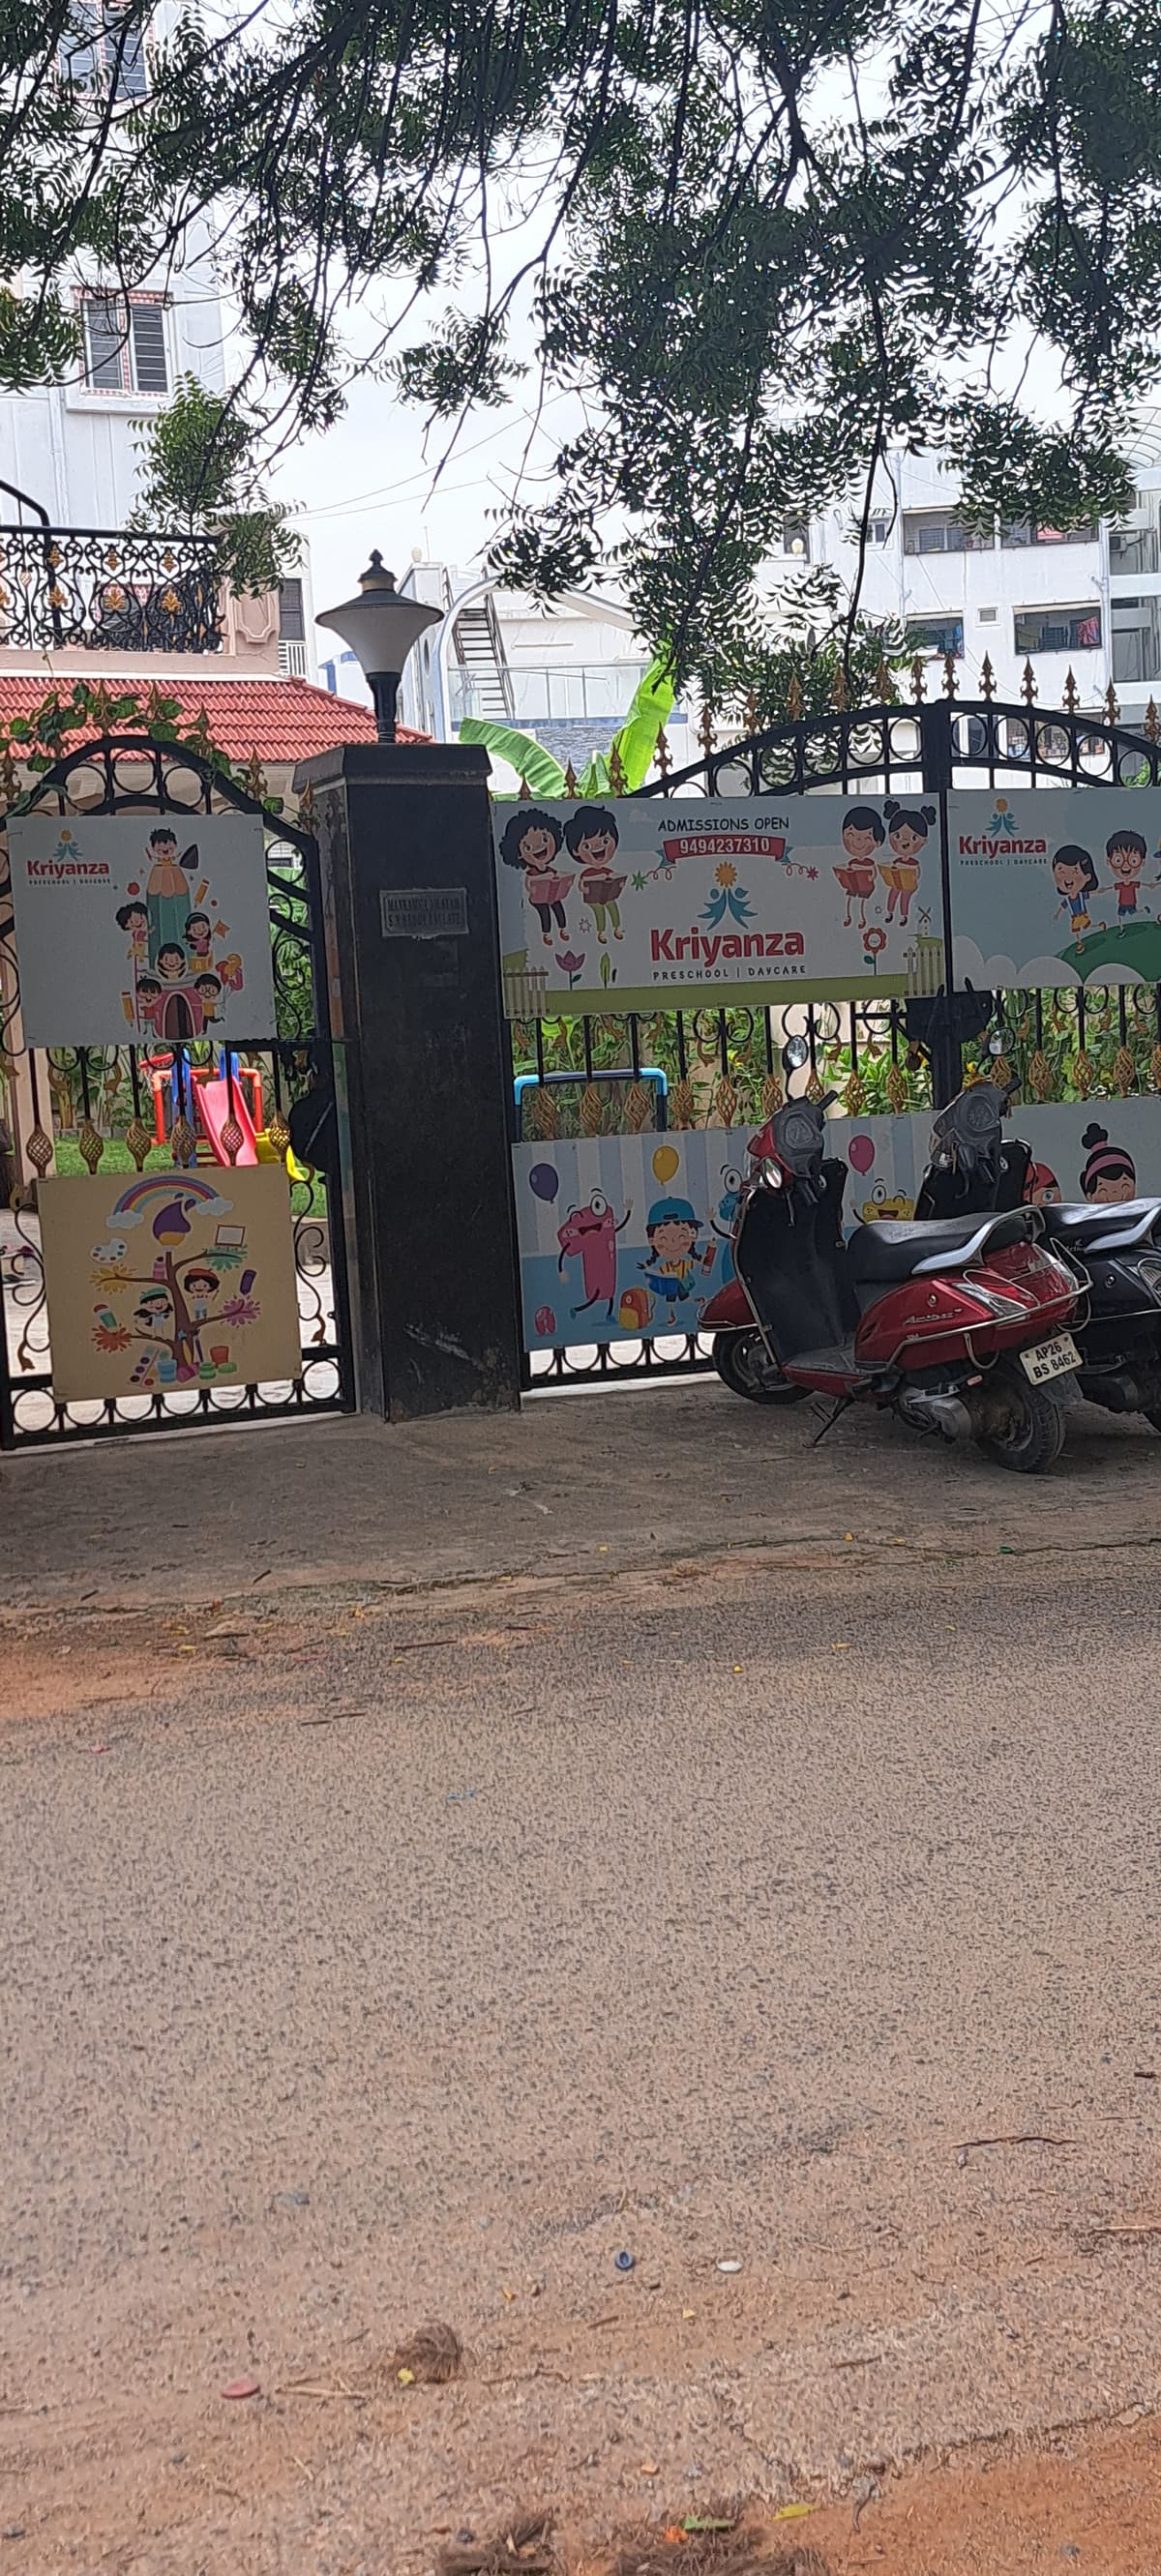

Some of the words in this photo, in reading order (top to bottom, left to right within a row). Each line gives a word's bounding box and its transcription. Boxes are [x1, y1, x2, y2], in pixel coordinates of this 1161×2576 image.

[658, 818, 749, 832] ADMISSIONS
[755, 816, 789, 830] OPEN
[679, 837, 770, 854] 9494237310
[959, 835, 1047, 859] Kriyanza
[26, 859, 109, 879] Kriyanza
[650, 926, 805, 967] Kriyanza
[653, 969, 729, 981] PRESCHOOL
[748, 965, 806, 976] DAYCARE
[1035, 1341, 1062, 1361] AP26
[1032, 1363, 1050, 1378] BS
[1050, 1351, 1077, 1371] 8462
